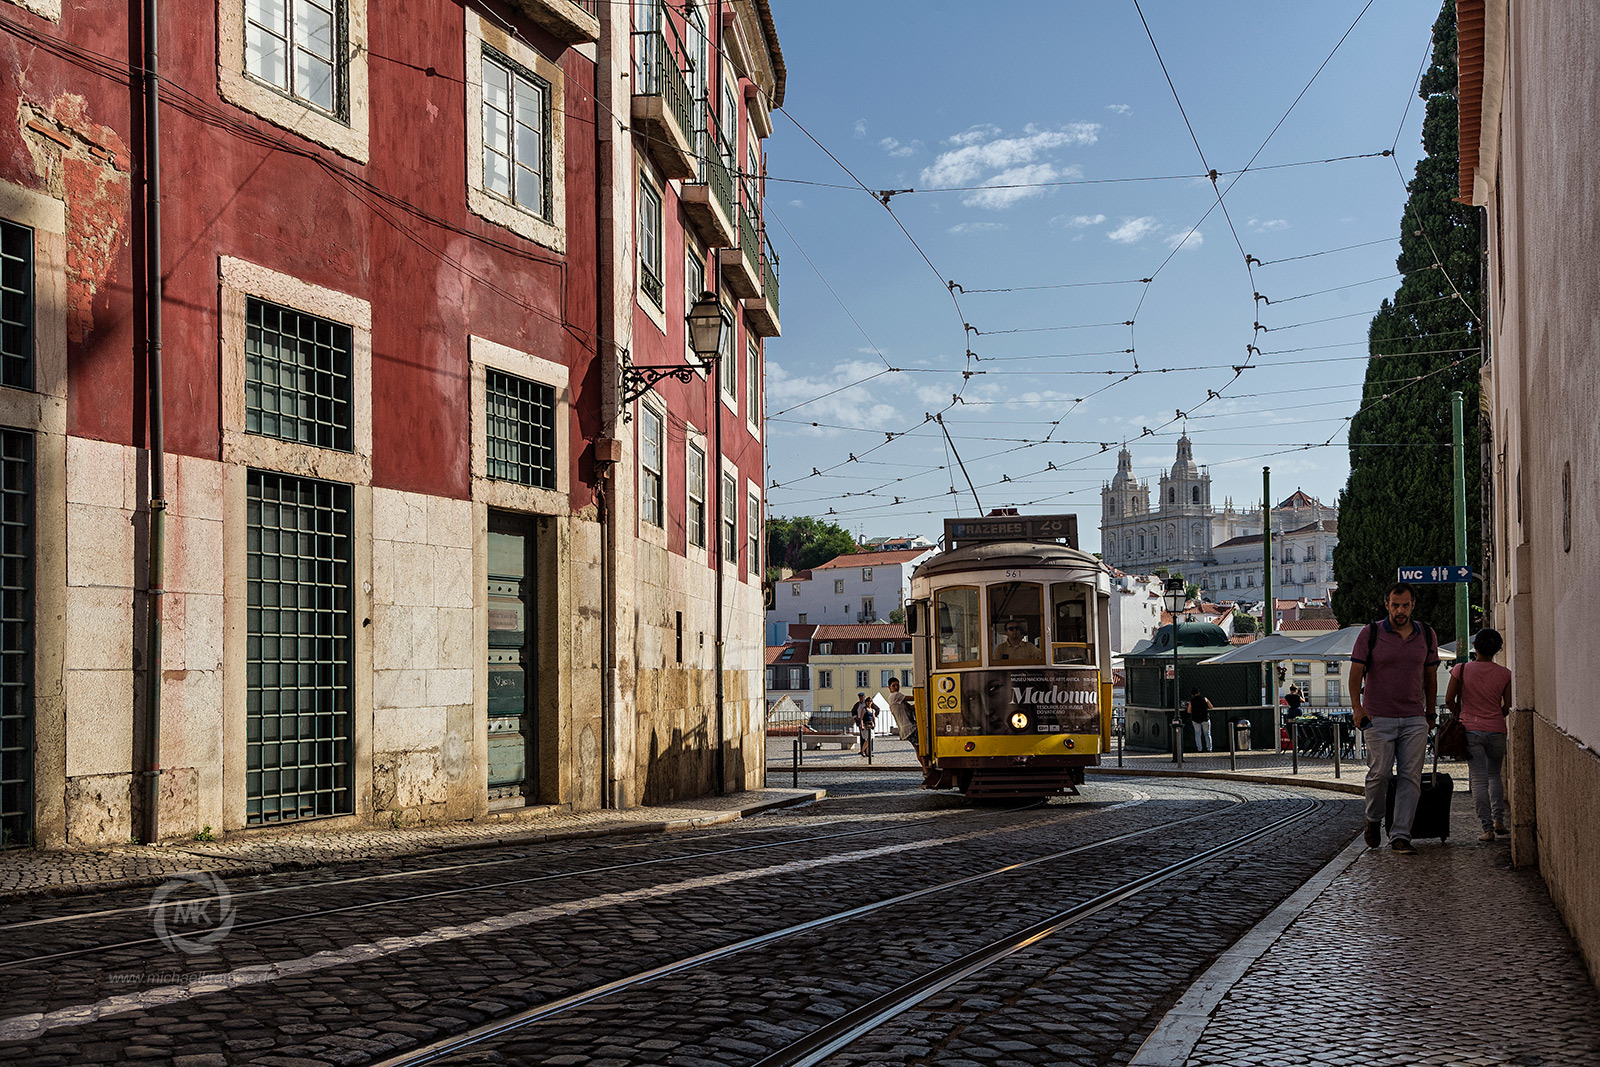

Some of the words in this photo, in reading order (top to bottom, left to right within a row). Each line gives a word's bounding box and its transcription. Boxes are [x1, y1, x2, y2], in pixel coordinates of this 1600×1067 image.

[957, 522, 1022, 535] PRAZERES
[1040, 520, 1063, 531] 28
[1005, 570, 1022, 578] 561
[1401, 570, 1423, 580] WC
[1009, 684, 1098, 705] Madonna
